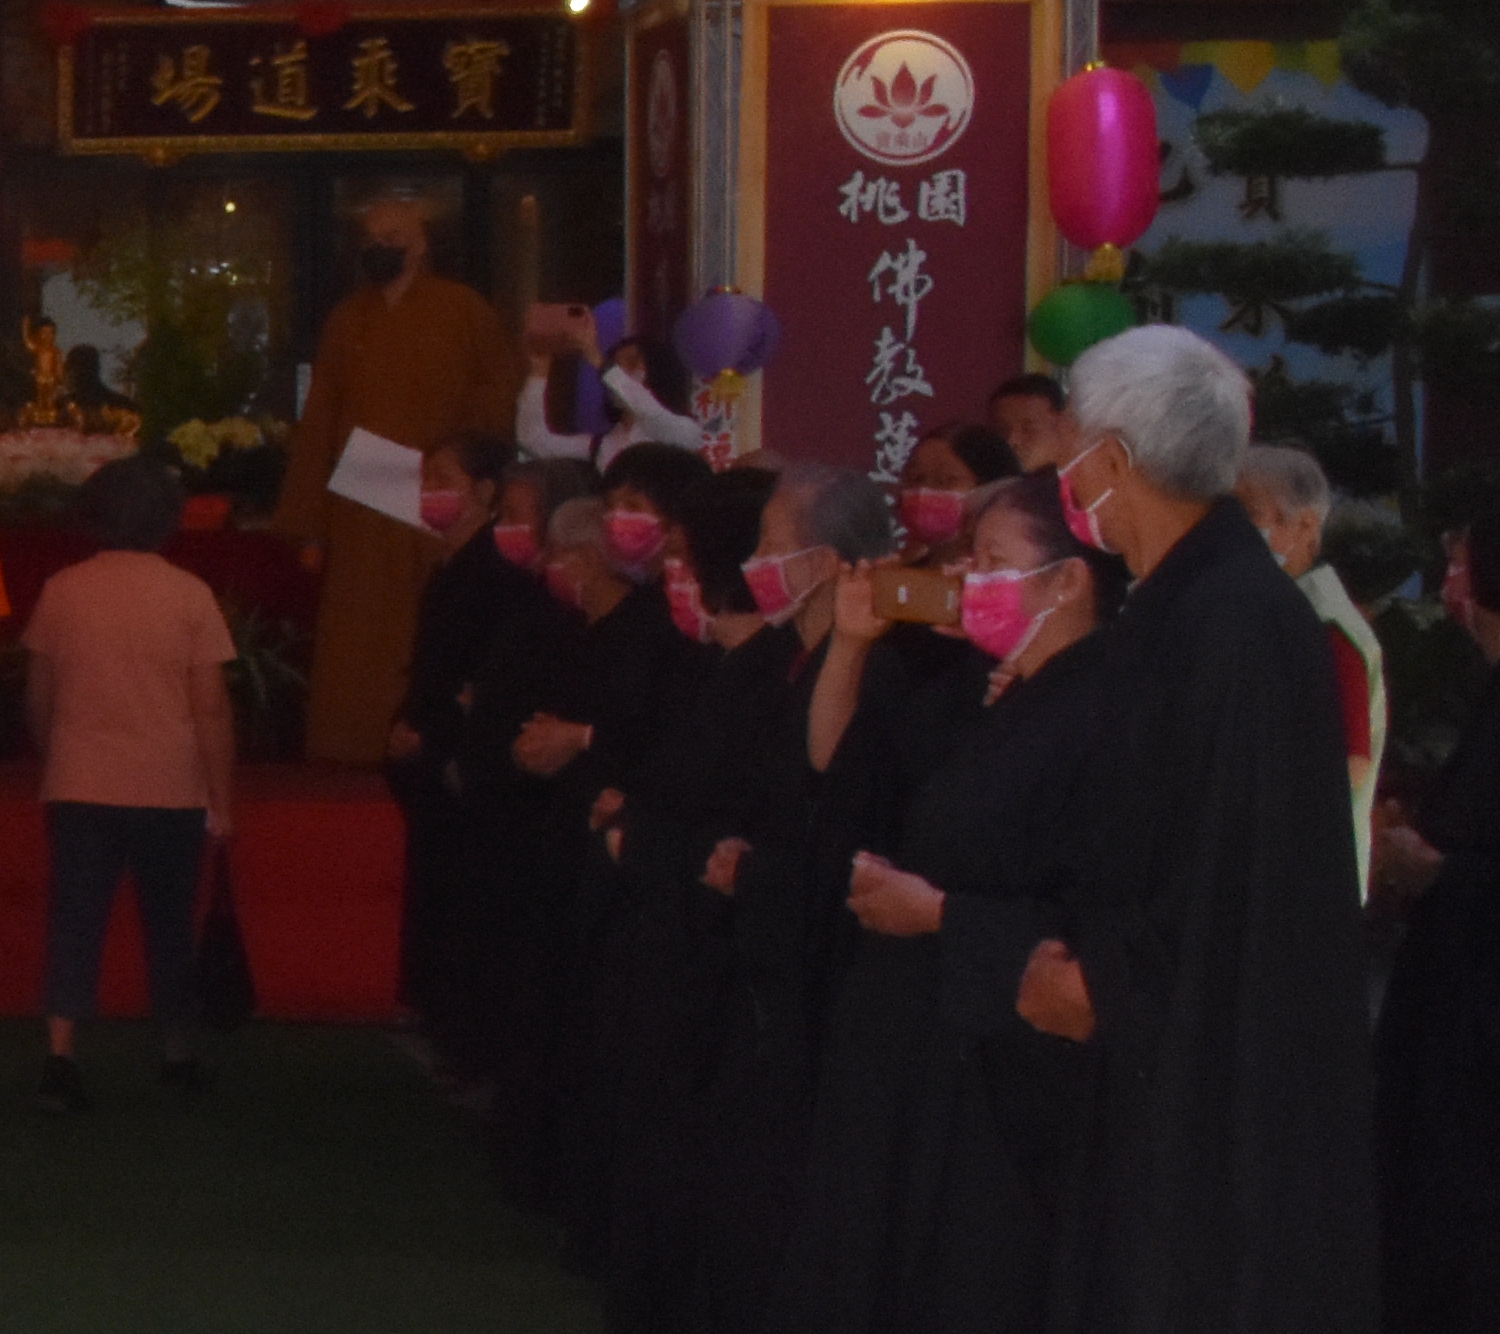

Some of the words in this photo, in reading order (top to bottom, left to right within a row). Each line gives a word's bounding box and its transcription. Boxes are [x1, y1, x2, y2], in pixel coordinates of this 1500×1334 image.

[838, 169, 967, 227] 桃園
[865, 242, 936, 549] 佛教蓮
